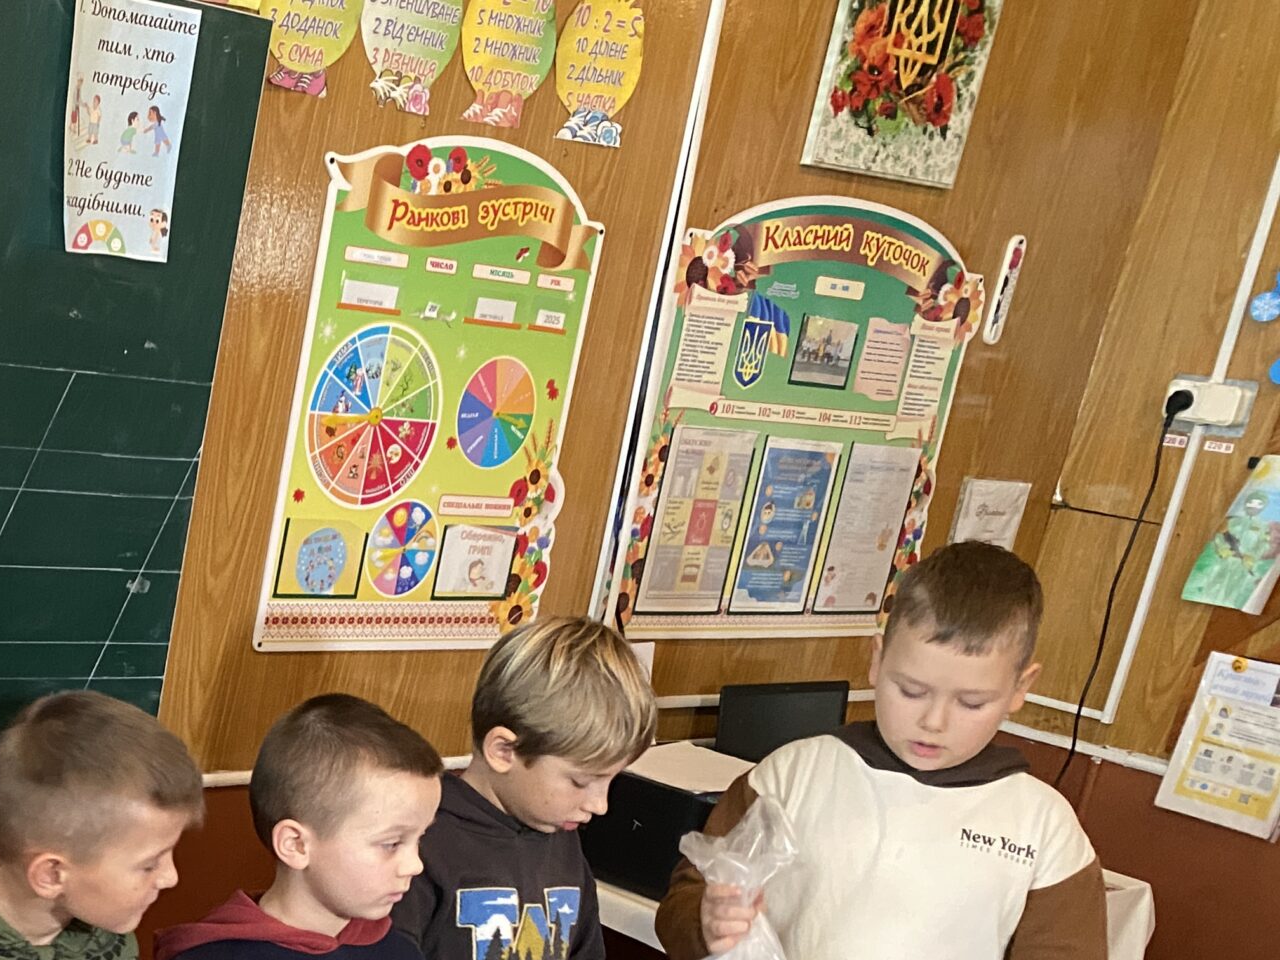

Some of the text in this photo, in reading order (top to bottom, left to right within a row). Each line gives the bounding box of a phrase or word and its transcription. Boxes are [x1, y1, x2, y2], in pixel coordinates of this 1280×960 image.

[91, 0, 197, 36] Допомагайте
[279, 11, 342, 39] ДОДАНОК
[373, 17, 381, 34] 2
[488, 10, 545, 36] МНОЖНИК
[142, 47, 175, 64] хто
[288, 43, 324, 66] СУМА
[483, 37, 540, 64] МНОЖНИК
[381, 50, 437, 80] РІЗНИЦЯ
[575, 61, 624, 86] ДІЛЬНИК
[92, 70, 170, 100] потребує.
[483, 68, 540, 91] ДОБУТОК
[95, 161, 153, 190] будьте
[961, 828, 1037, 859] New York
